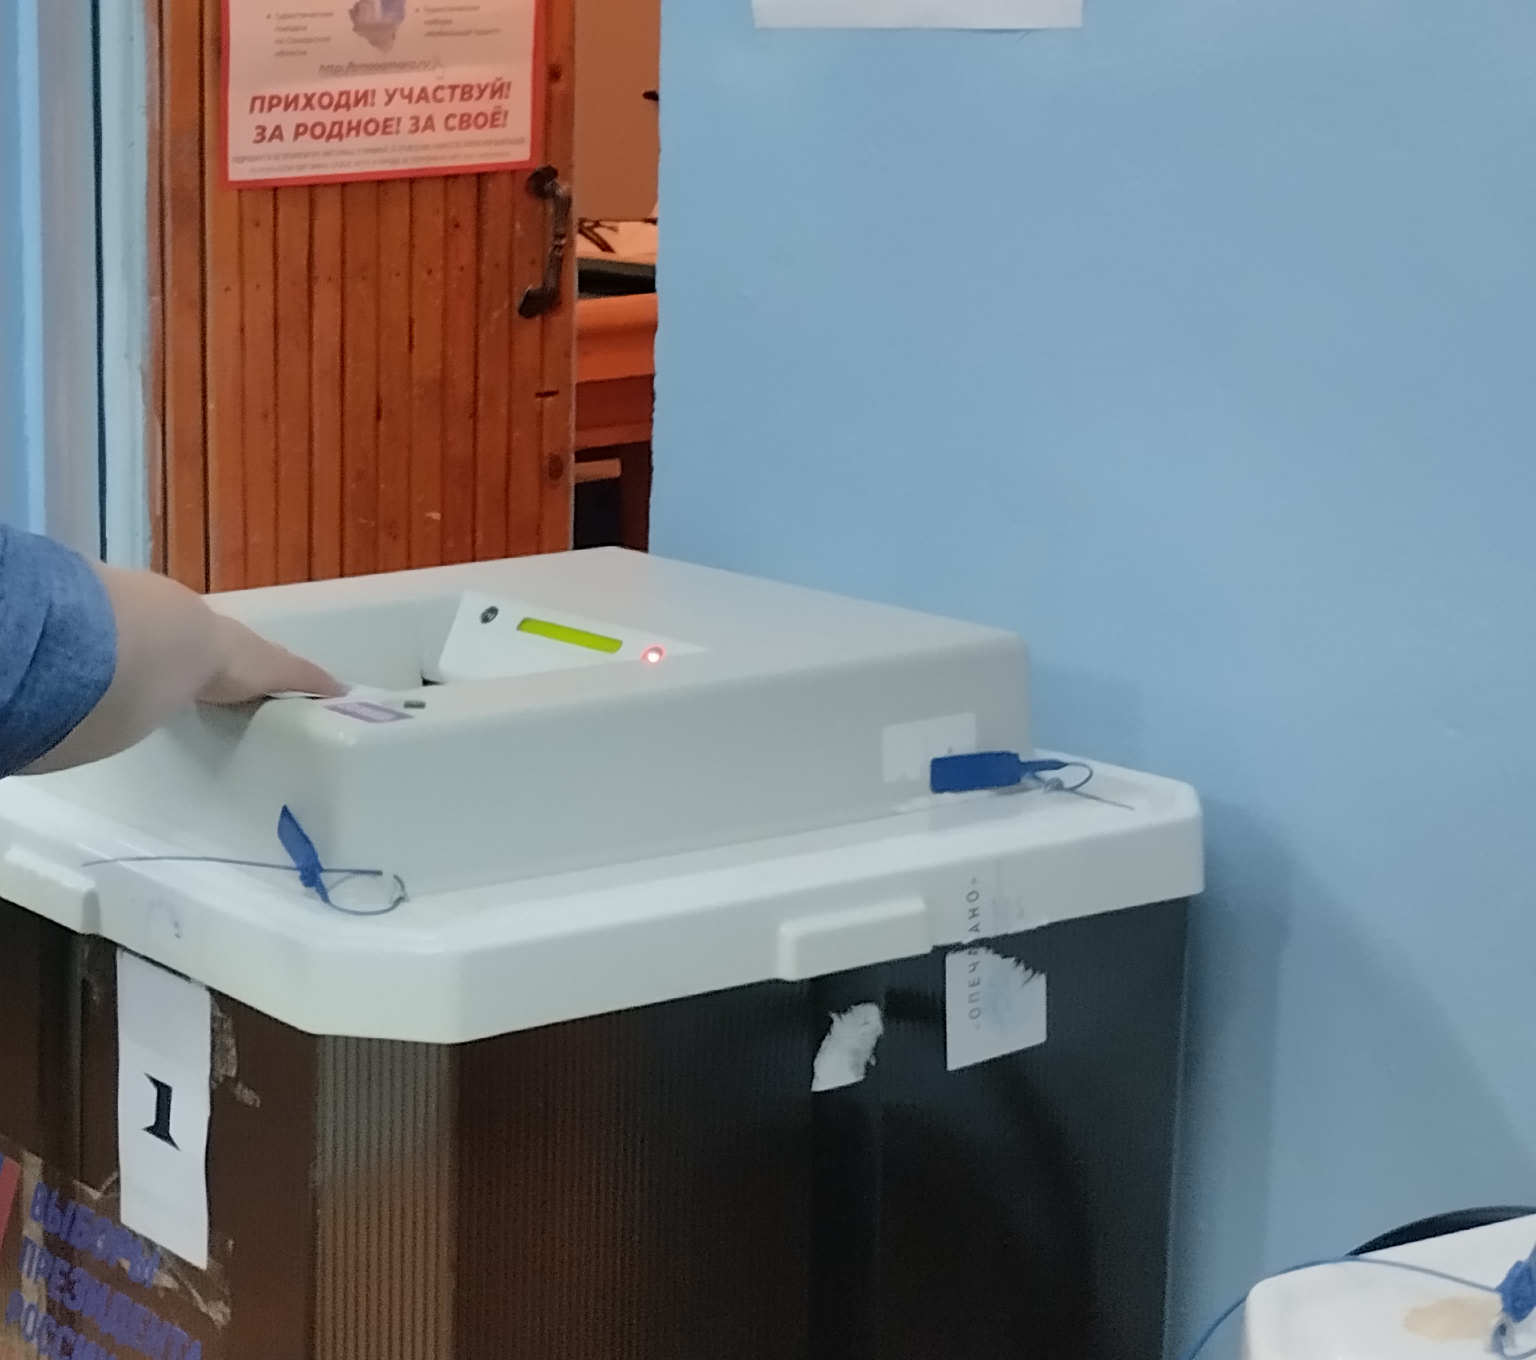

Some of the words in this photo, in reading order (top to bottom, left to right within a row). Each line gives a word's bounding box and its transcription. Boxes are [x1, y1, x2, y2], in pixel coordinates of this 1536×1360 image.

[248, 87, 377, 115] ПРИХОДИ!
[383, 76, 513, 107] УЧАСТВУЙ!
[252, 124, 285, 144] ЗА
[292, 117, 402, 144] РОДНОЕ!
[407, 115, 437, 135] ЗА
[443, 105, 510, 132] СВОЁ!
[142, 1071, 181, 1152] 1
